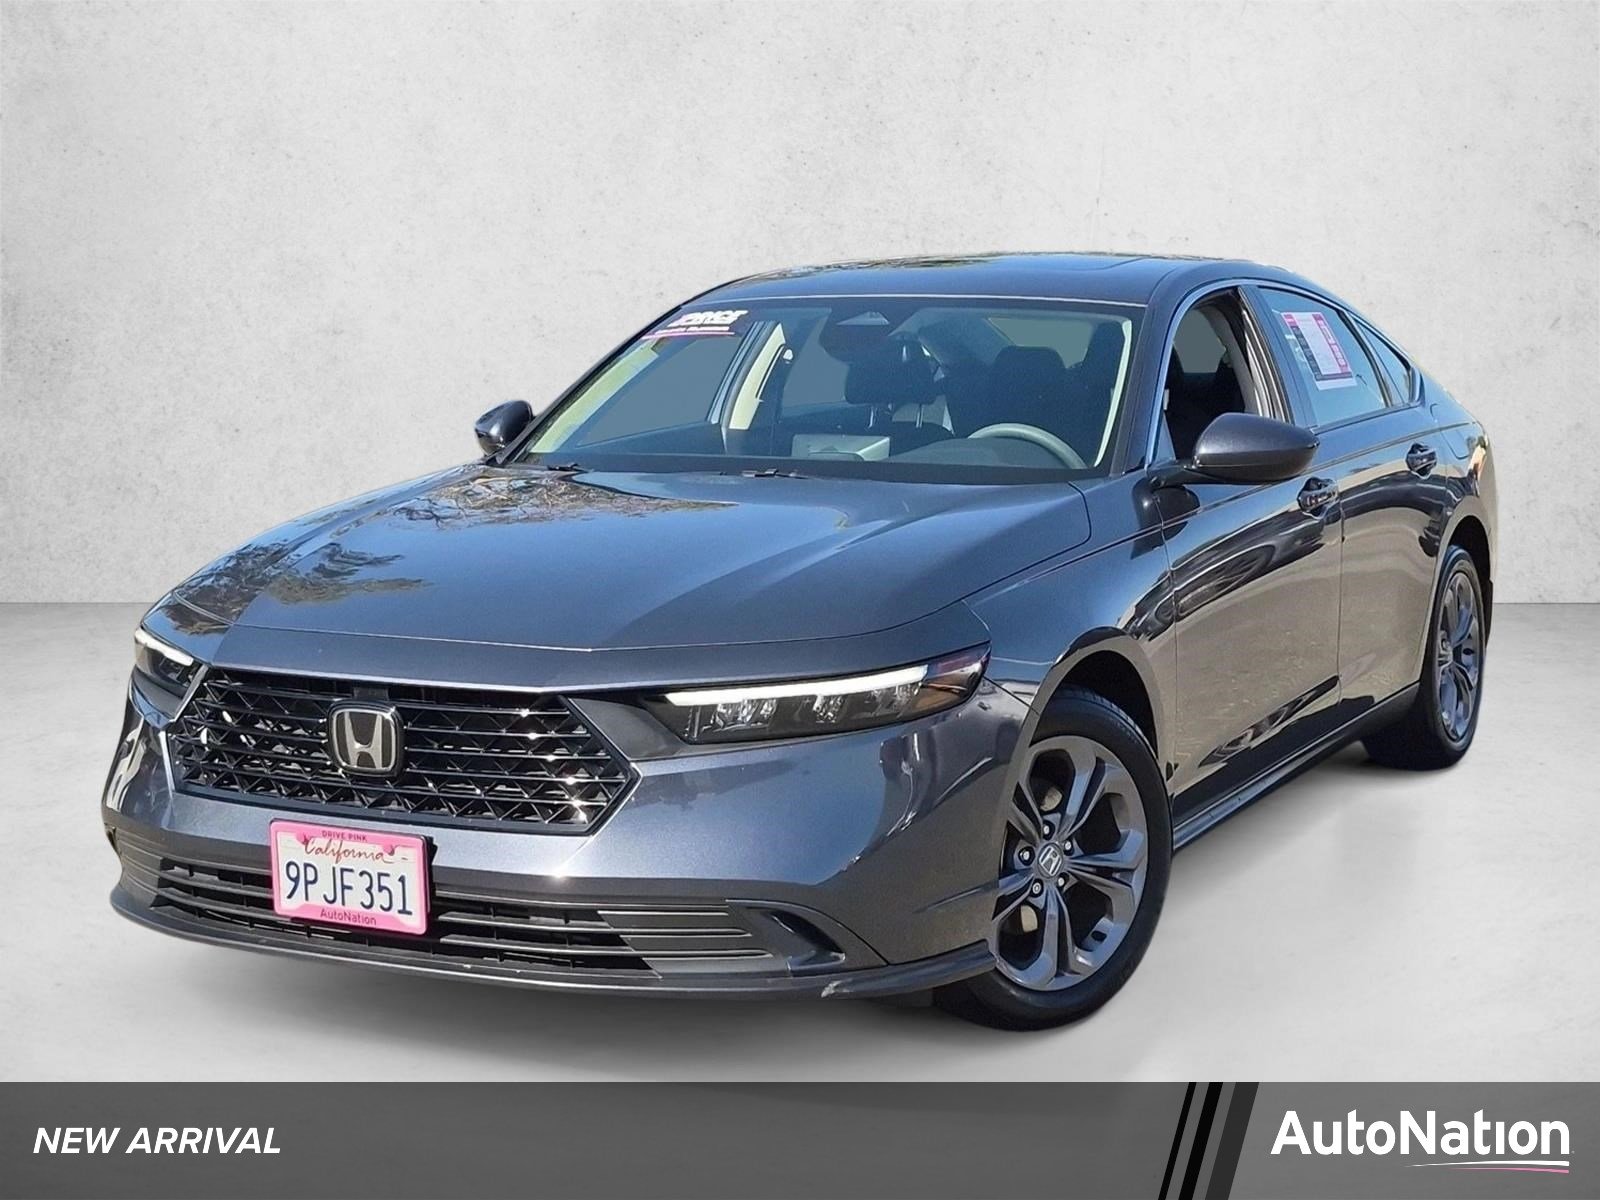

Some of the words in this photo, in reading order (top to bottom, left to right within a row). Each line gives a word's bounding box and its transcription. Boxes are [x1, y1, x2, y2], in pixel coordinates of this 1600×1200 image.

[321, 830, 346, 840] DRIVE
[348, 833, 368, 843] PINK
[304, 837, 394, 864] California
[320, 908, 377, 926] AutoNation
